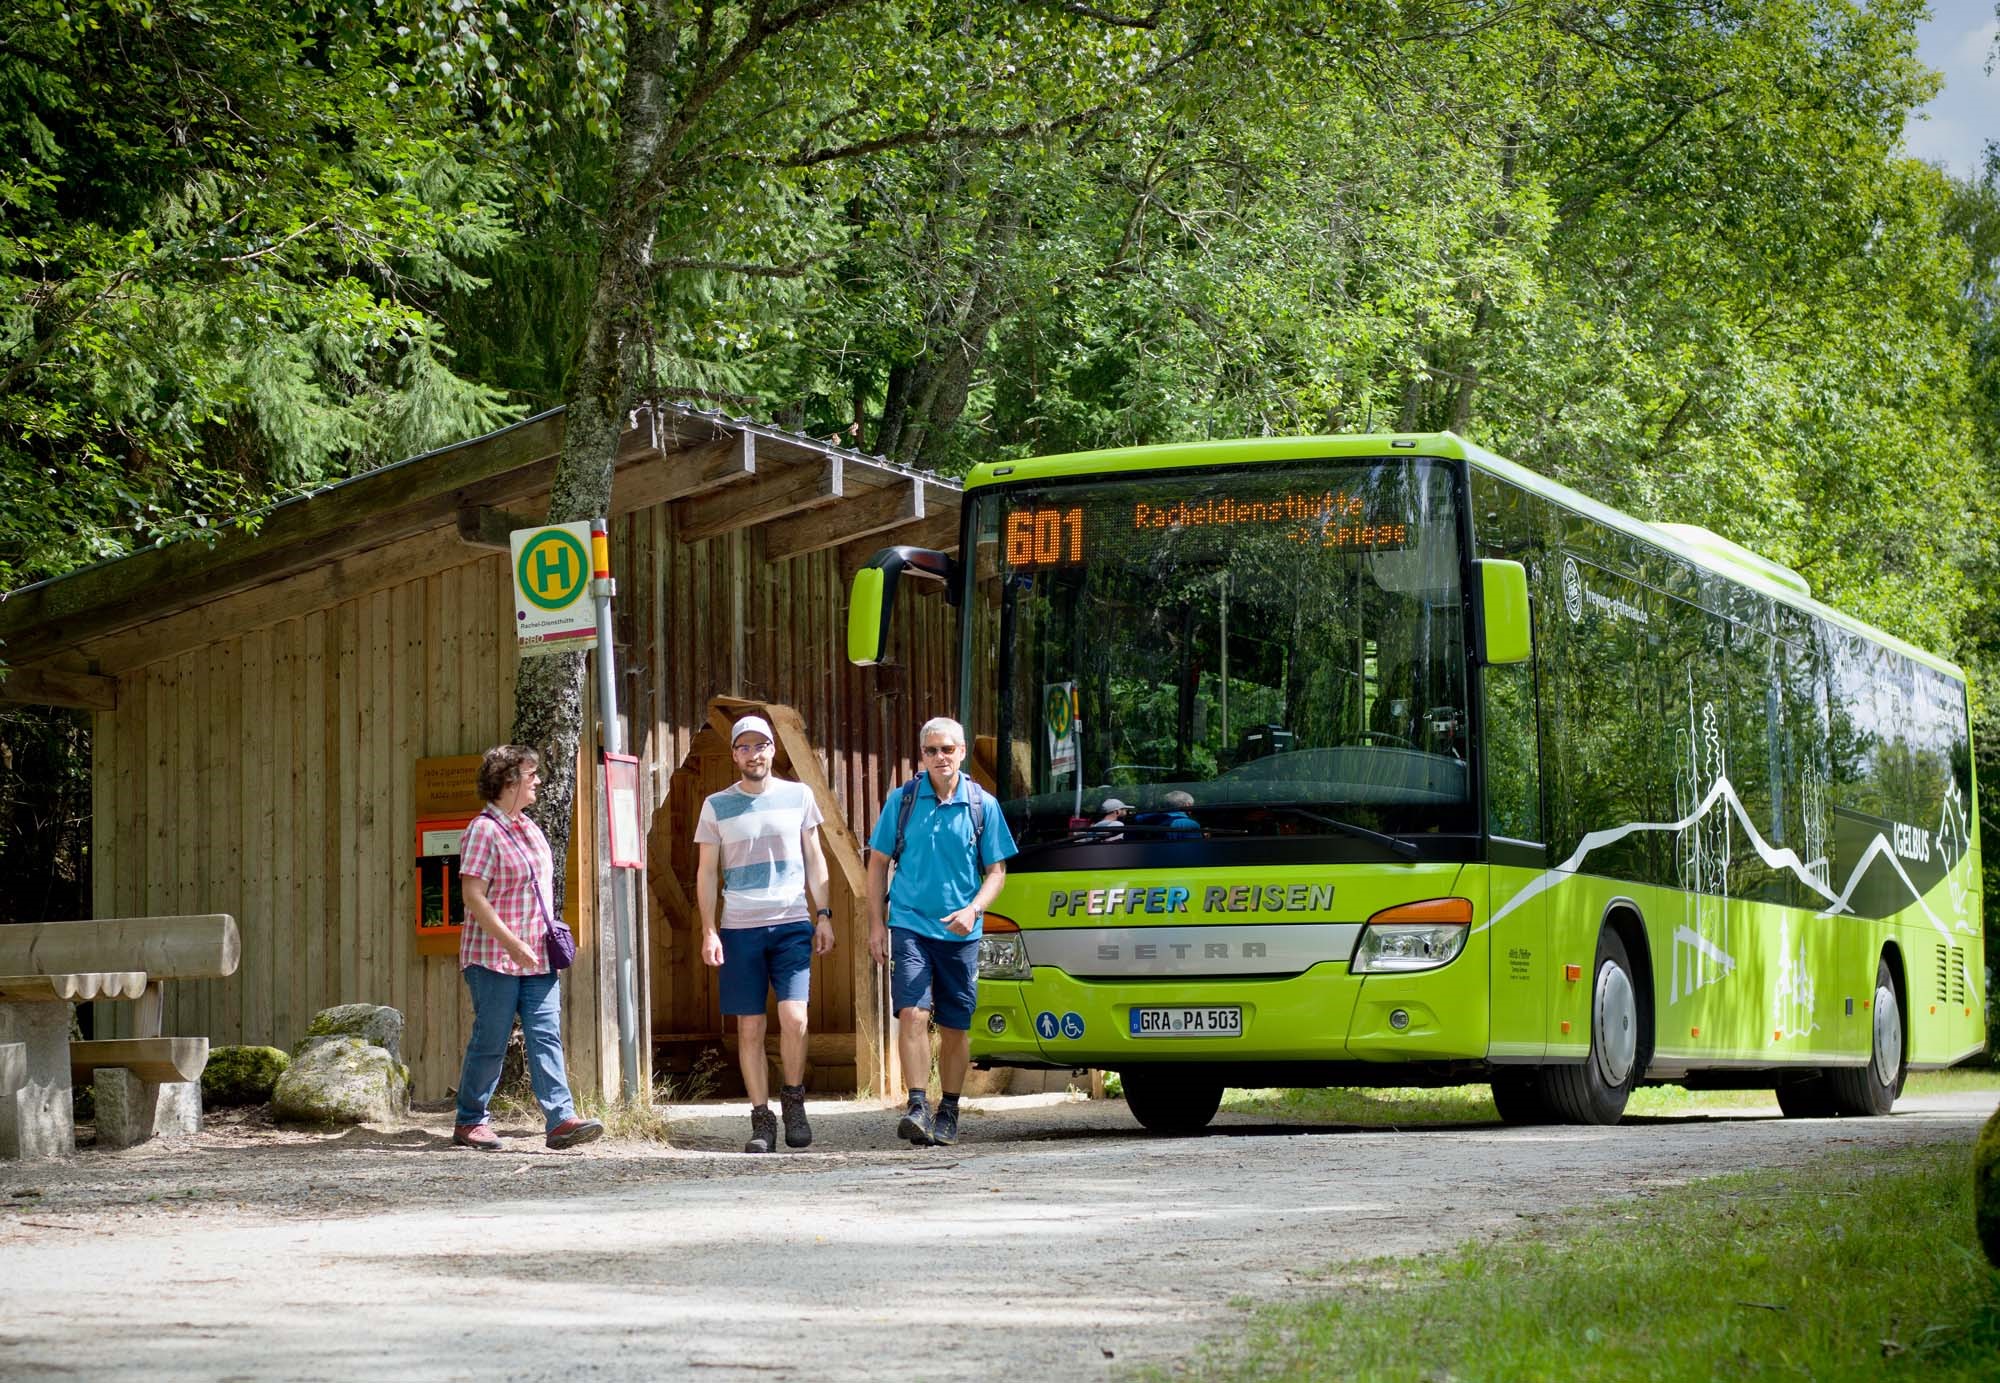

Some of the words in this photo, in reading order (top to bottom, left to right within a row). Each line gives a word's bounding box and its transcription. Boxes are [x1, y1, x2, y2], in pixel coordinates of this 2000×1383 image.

[1134, 490, 1364, 529] Racheldiensthütte
[1006, 507, 1083, 565] 601
[535, 547, 571, 592] H
[520, 617, 575, 629] Rachel-Diensthütte
[1893, 821, 1930, 864] IGELBUS
[1048, 886, 1190, 917] PFEFFER
[1203, 884, 1335, 913] REISEN
[1097, 942, 1267, 960] SETRA
[1140, 1010, 1171, 1032] GRA
[1183, 1011, 1204, 1031] PA
[1208, 1010, 1239, 1030] 503
